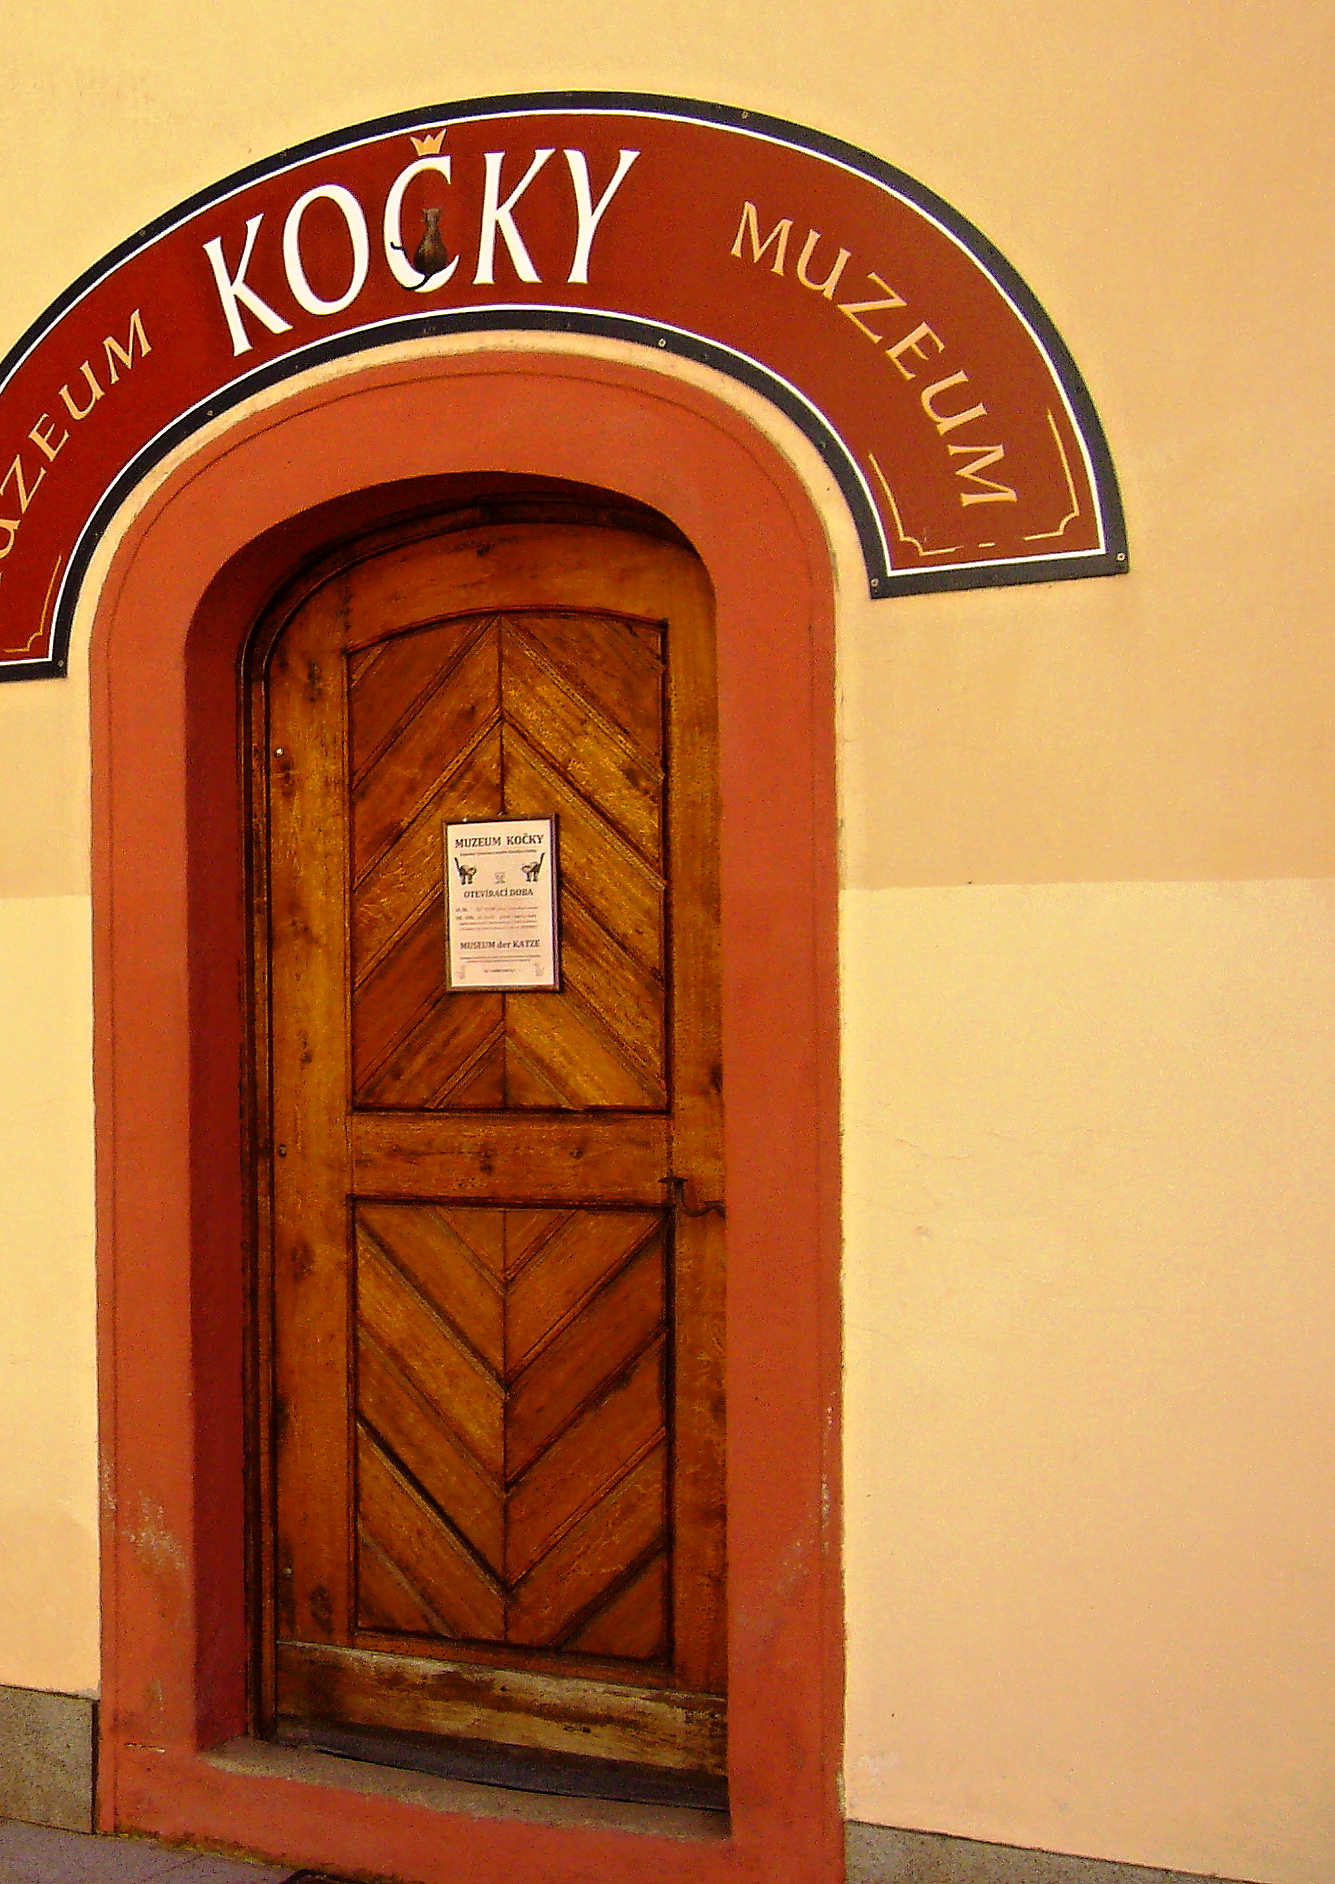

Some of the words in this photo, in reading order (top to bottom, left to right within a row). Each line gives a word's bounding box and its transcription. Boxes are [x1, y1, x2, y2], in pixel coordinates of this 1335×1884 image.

[202, 128, 642, 357] KOČKY
[731, 200, 1018, 507] MUZEUM
[455, 836, 502, 849] MUZEUM
[506, 833, 544, 846] KOČKY
[460, 941, 496, 950] MUSEUM
[512, 939, 541, 948] KATZE
